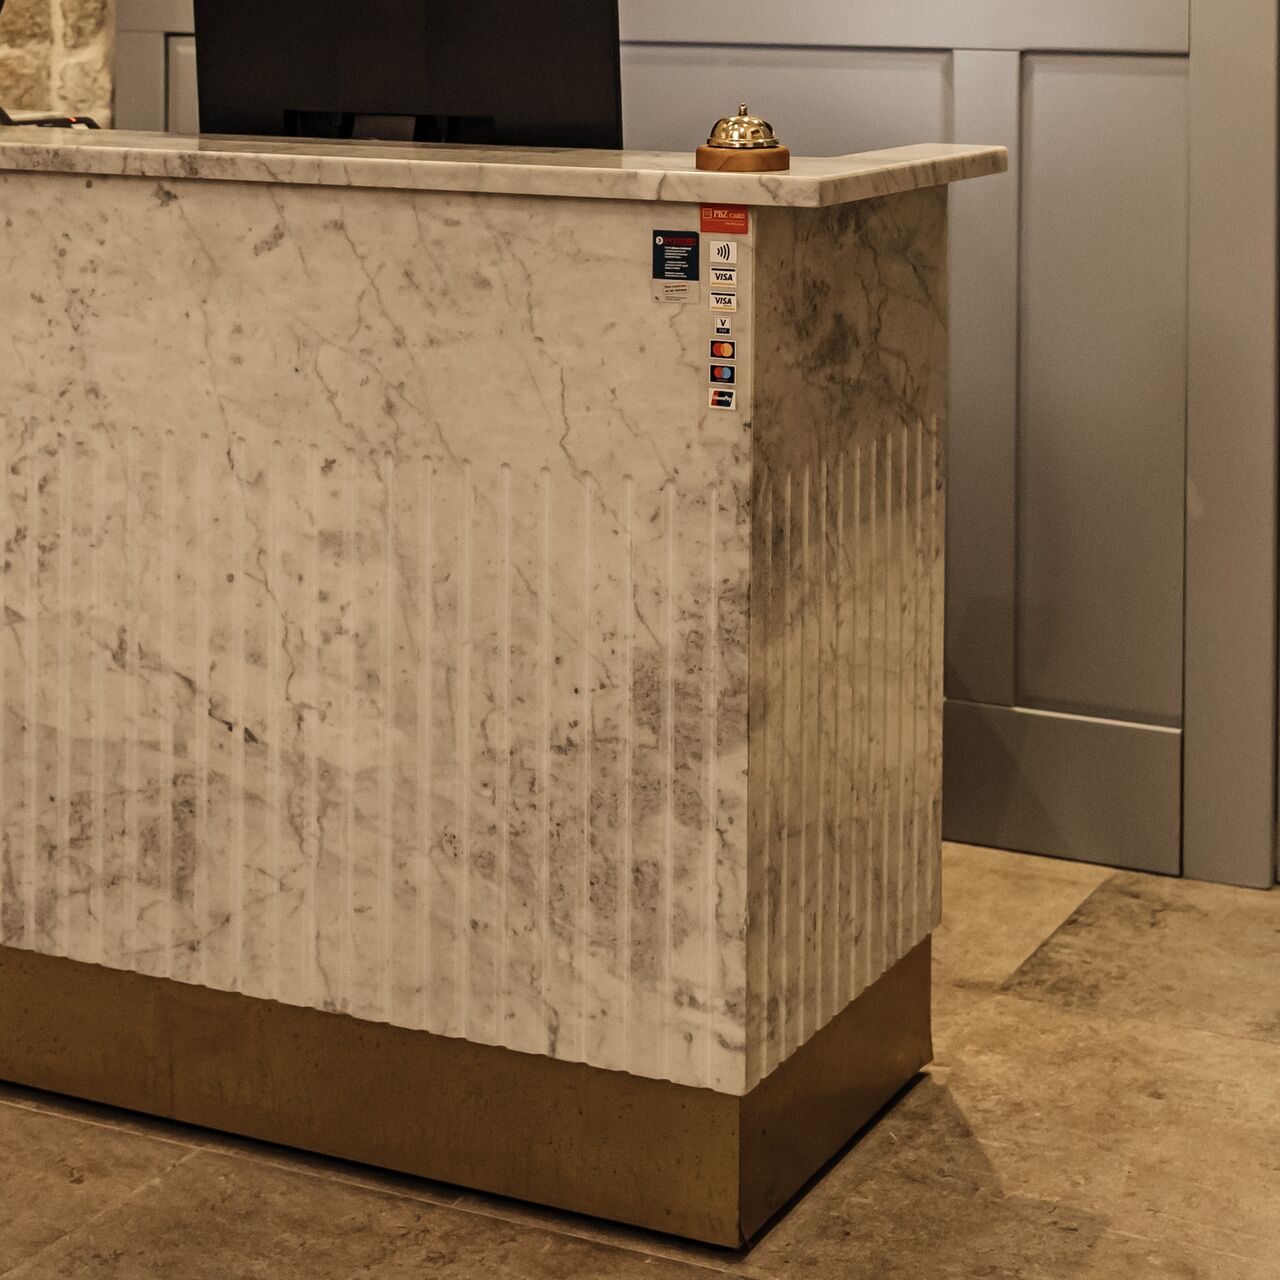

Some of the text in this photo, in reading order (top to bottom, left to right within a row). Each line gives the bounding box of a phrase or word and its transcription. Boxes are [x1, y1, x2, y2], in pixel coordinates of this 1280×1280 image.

[714, 272, 733, 281] VISA
[714, 296, 732, 305] VISA
[720, 319, 727, 327] V
